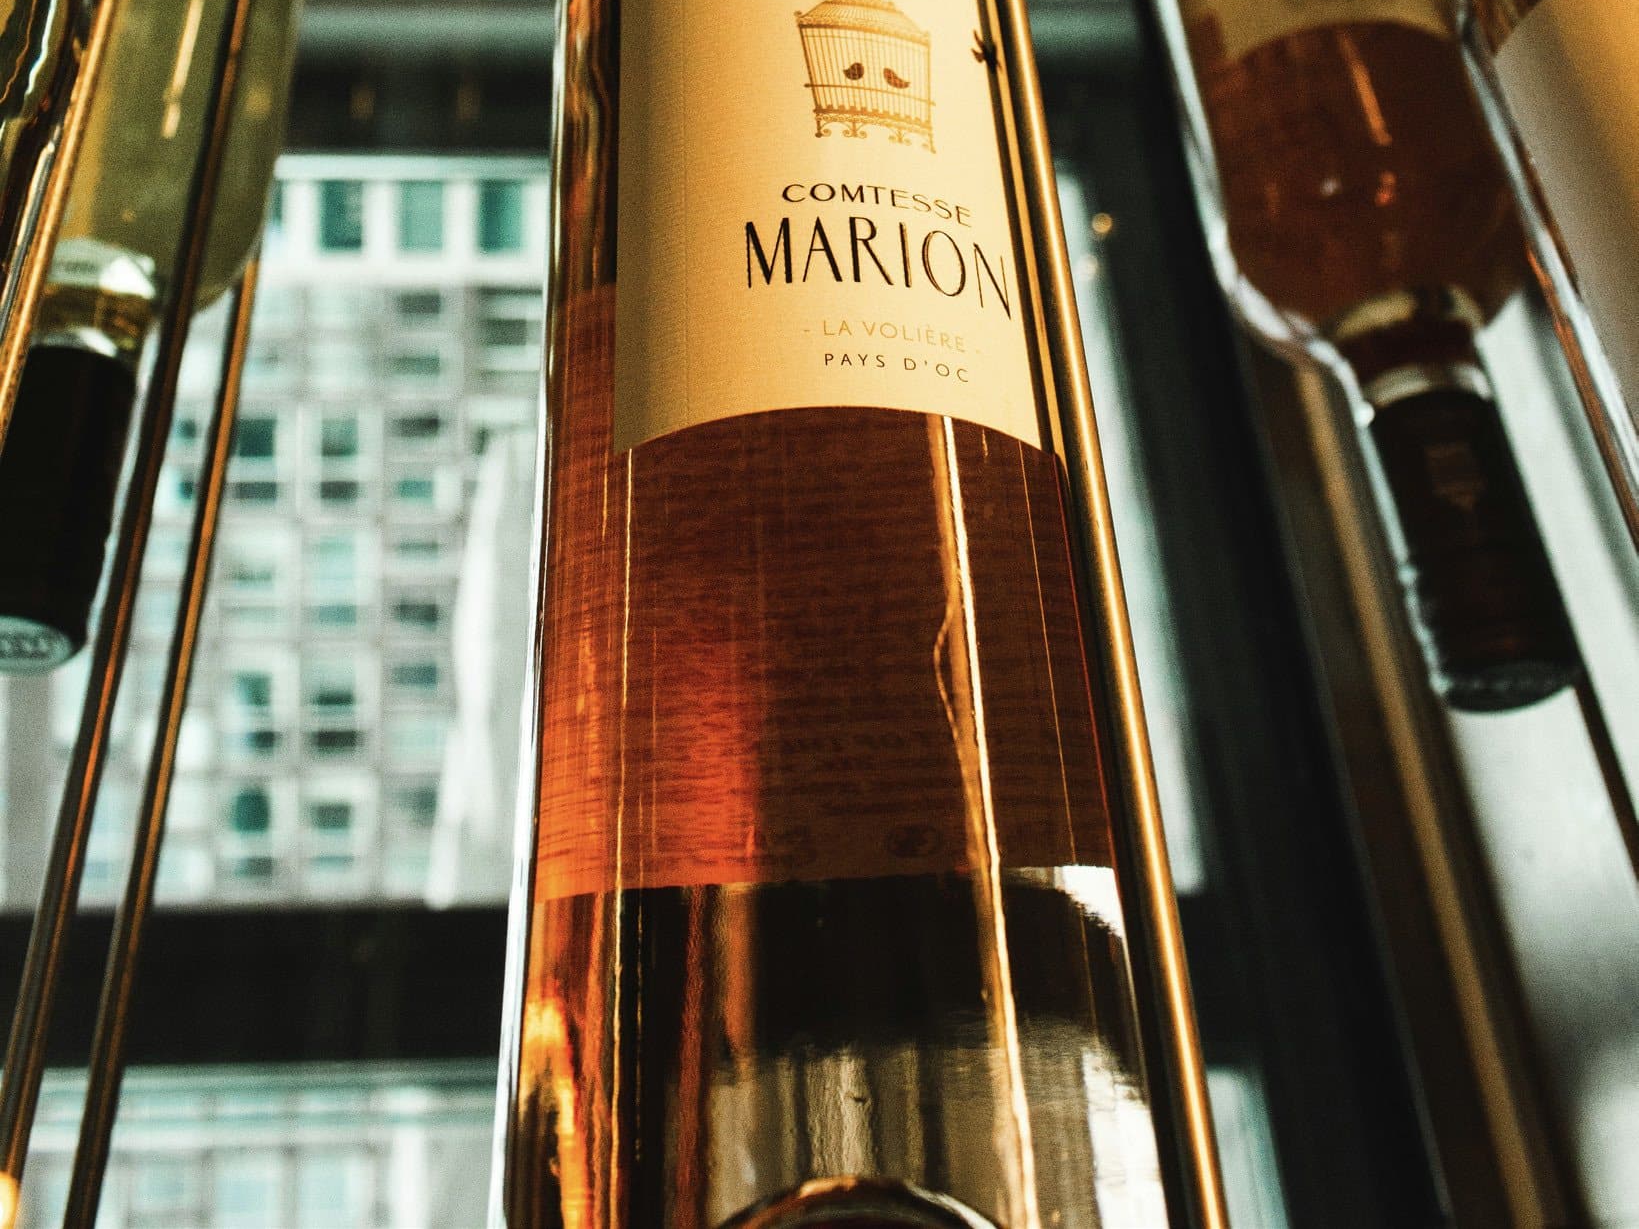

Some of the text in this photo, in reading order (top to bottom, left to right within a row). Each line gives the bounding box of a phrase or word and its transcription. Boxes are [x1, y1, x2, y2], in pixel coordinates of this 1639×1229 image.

[781, 182, 973, 229] COMTESSE
[744, 215, 1012, 322] MARION
[822, 319, 967, 354] LA VOLIÈRE
[823, 352, 970, 384] PAYS D'OC
